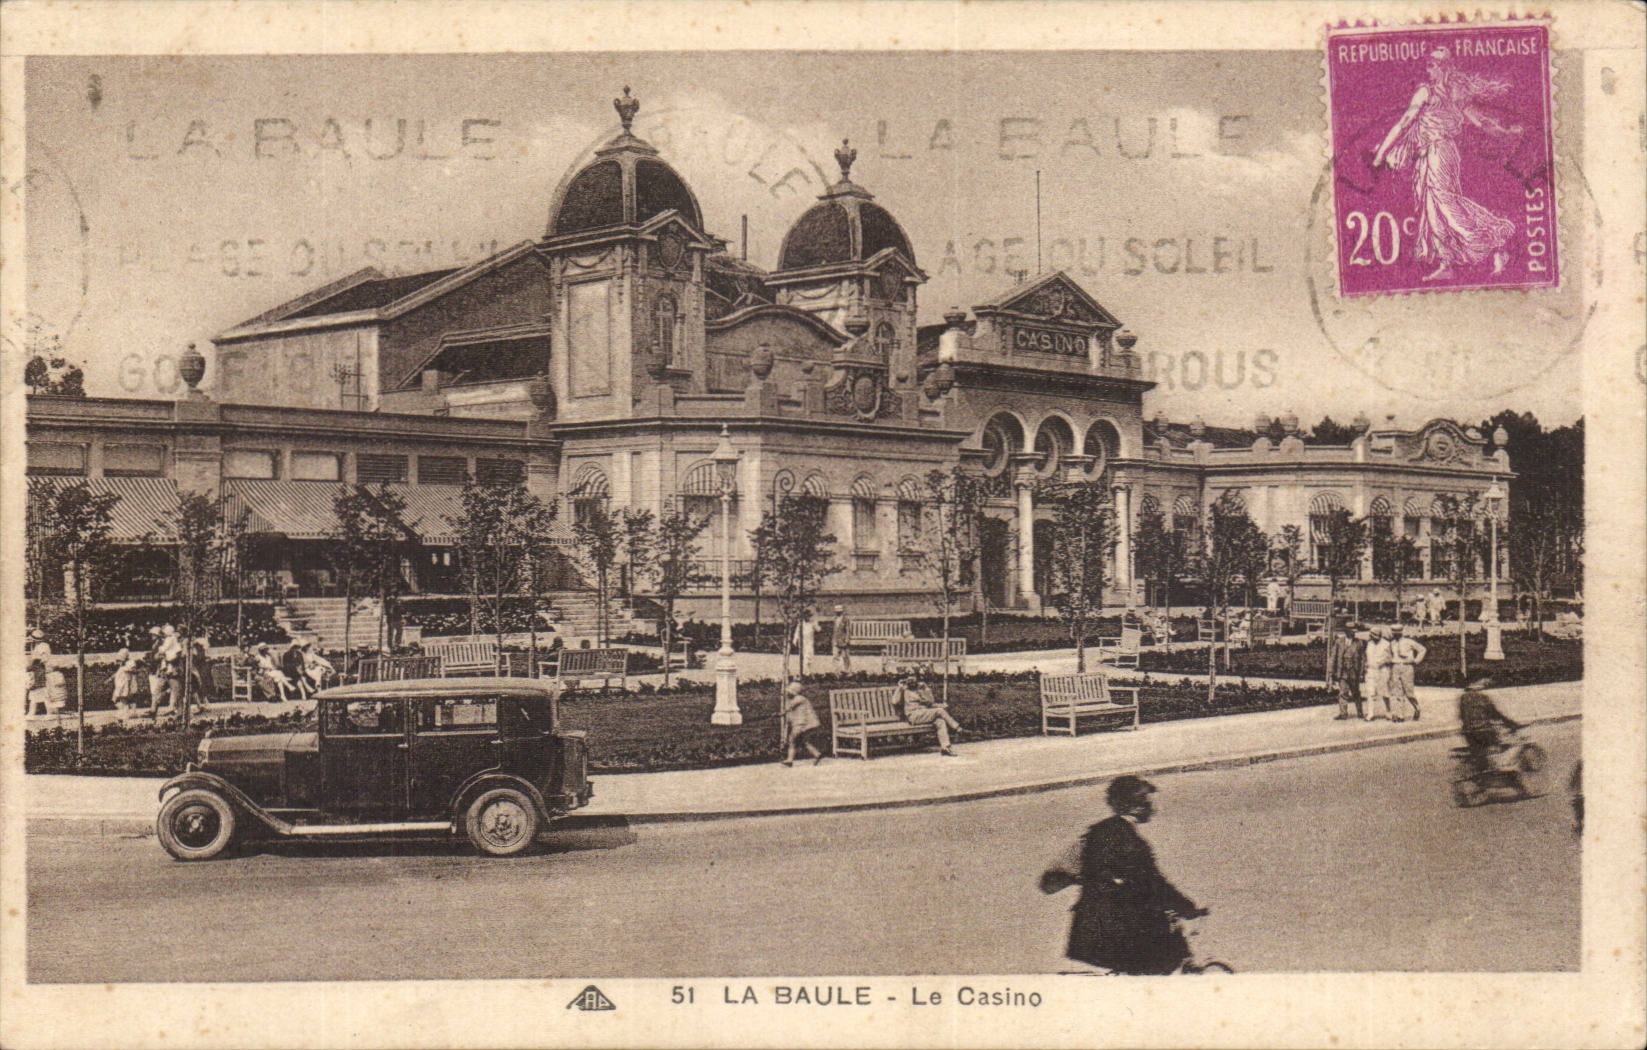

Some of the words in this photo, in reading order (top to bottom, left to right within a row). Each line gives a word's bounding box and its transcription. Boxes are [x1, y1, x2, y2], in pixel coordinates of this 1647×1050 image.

[1455, 37, 1537, 57] FRANÇAISE
[125, 119, 222, 161] LA
[253, 117, 501, 162] BAULE
[877, 119, 953, 160] LA
[999, 115, 1250, 161] BAULE
[1525, 187, 1547, 272] POSTES
[1124, 237, 1275, 276] SOLEIL
[1016, 330, 1086, 351] CASINO
